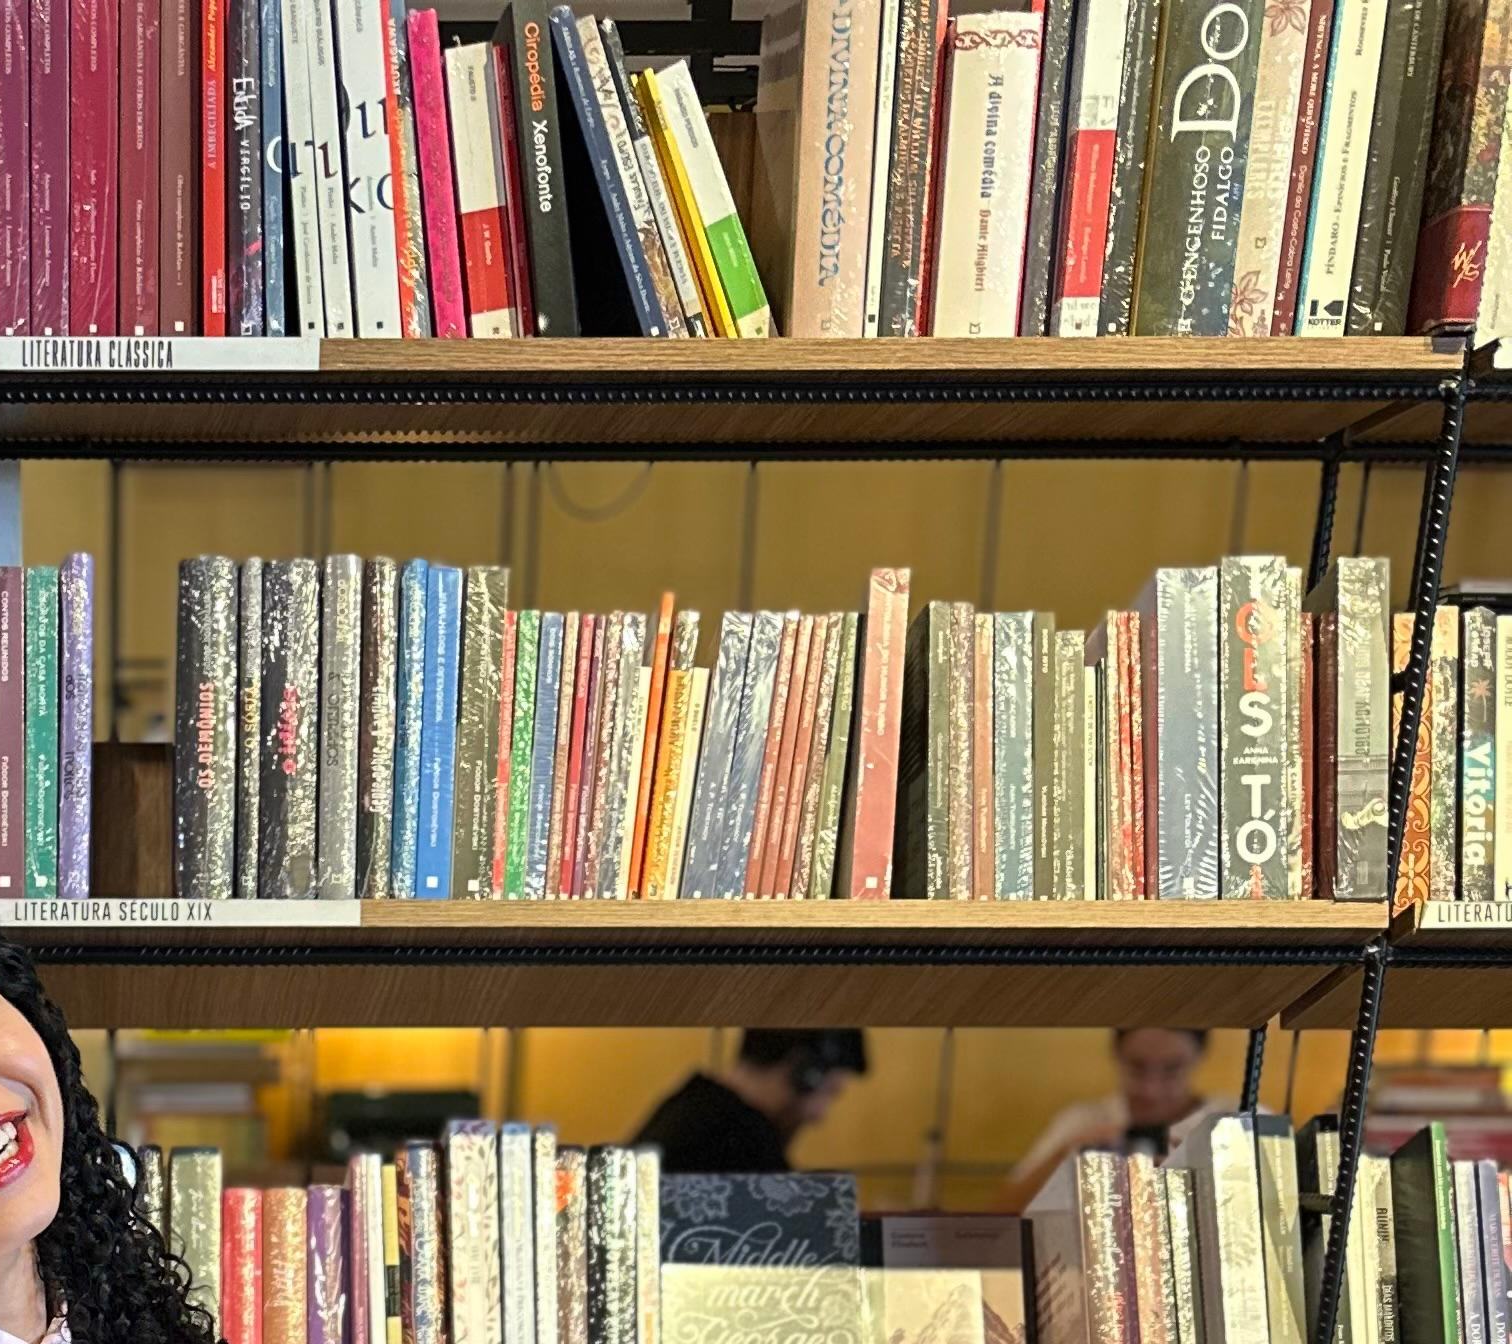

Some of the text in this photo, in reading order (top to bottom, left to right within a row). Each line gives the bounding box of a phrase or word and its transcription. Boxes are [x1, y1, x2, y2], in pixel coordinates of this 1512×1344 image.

[524, 23, 553, 214] Ciropédia Xenofonte
[984, 91, 1001, 136] divina
[980, 140, 998, 199] comédia
[818, 133, 846, 287] COMÉDIA
[1211, 146, 1234, 240] FIDALGO
[21, 337, 173, 368] LITERATURA CLÁSSICA
[1, 590, 9, 630] CONTOS
[1, 632, 9, 682] REUNIDOS
[1463, 742, 1494, 866] Vitória
[15, 900, 212, 921] LITERATURA SÉCULO XIX
[669, 1222, 818, 1268] Middle
[709, 1279, 820, 1309] march
[1470, 1310, 1479, 1320] A
[1494, 1310, 1504, 1319] A
